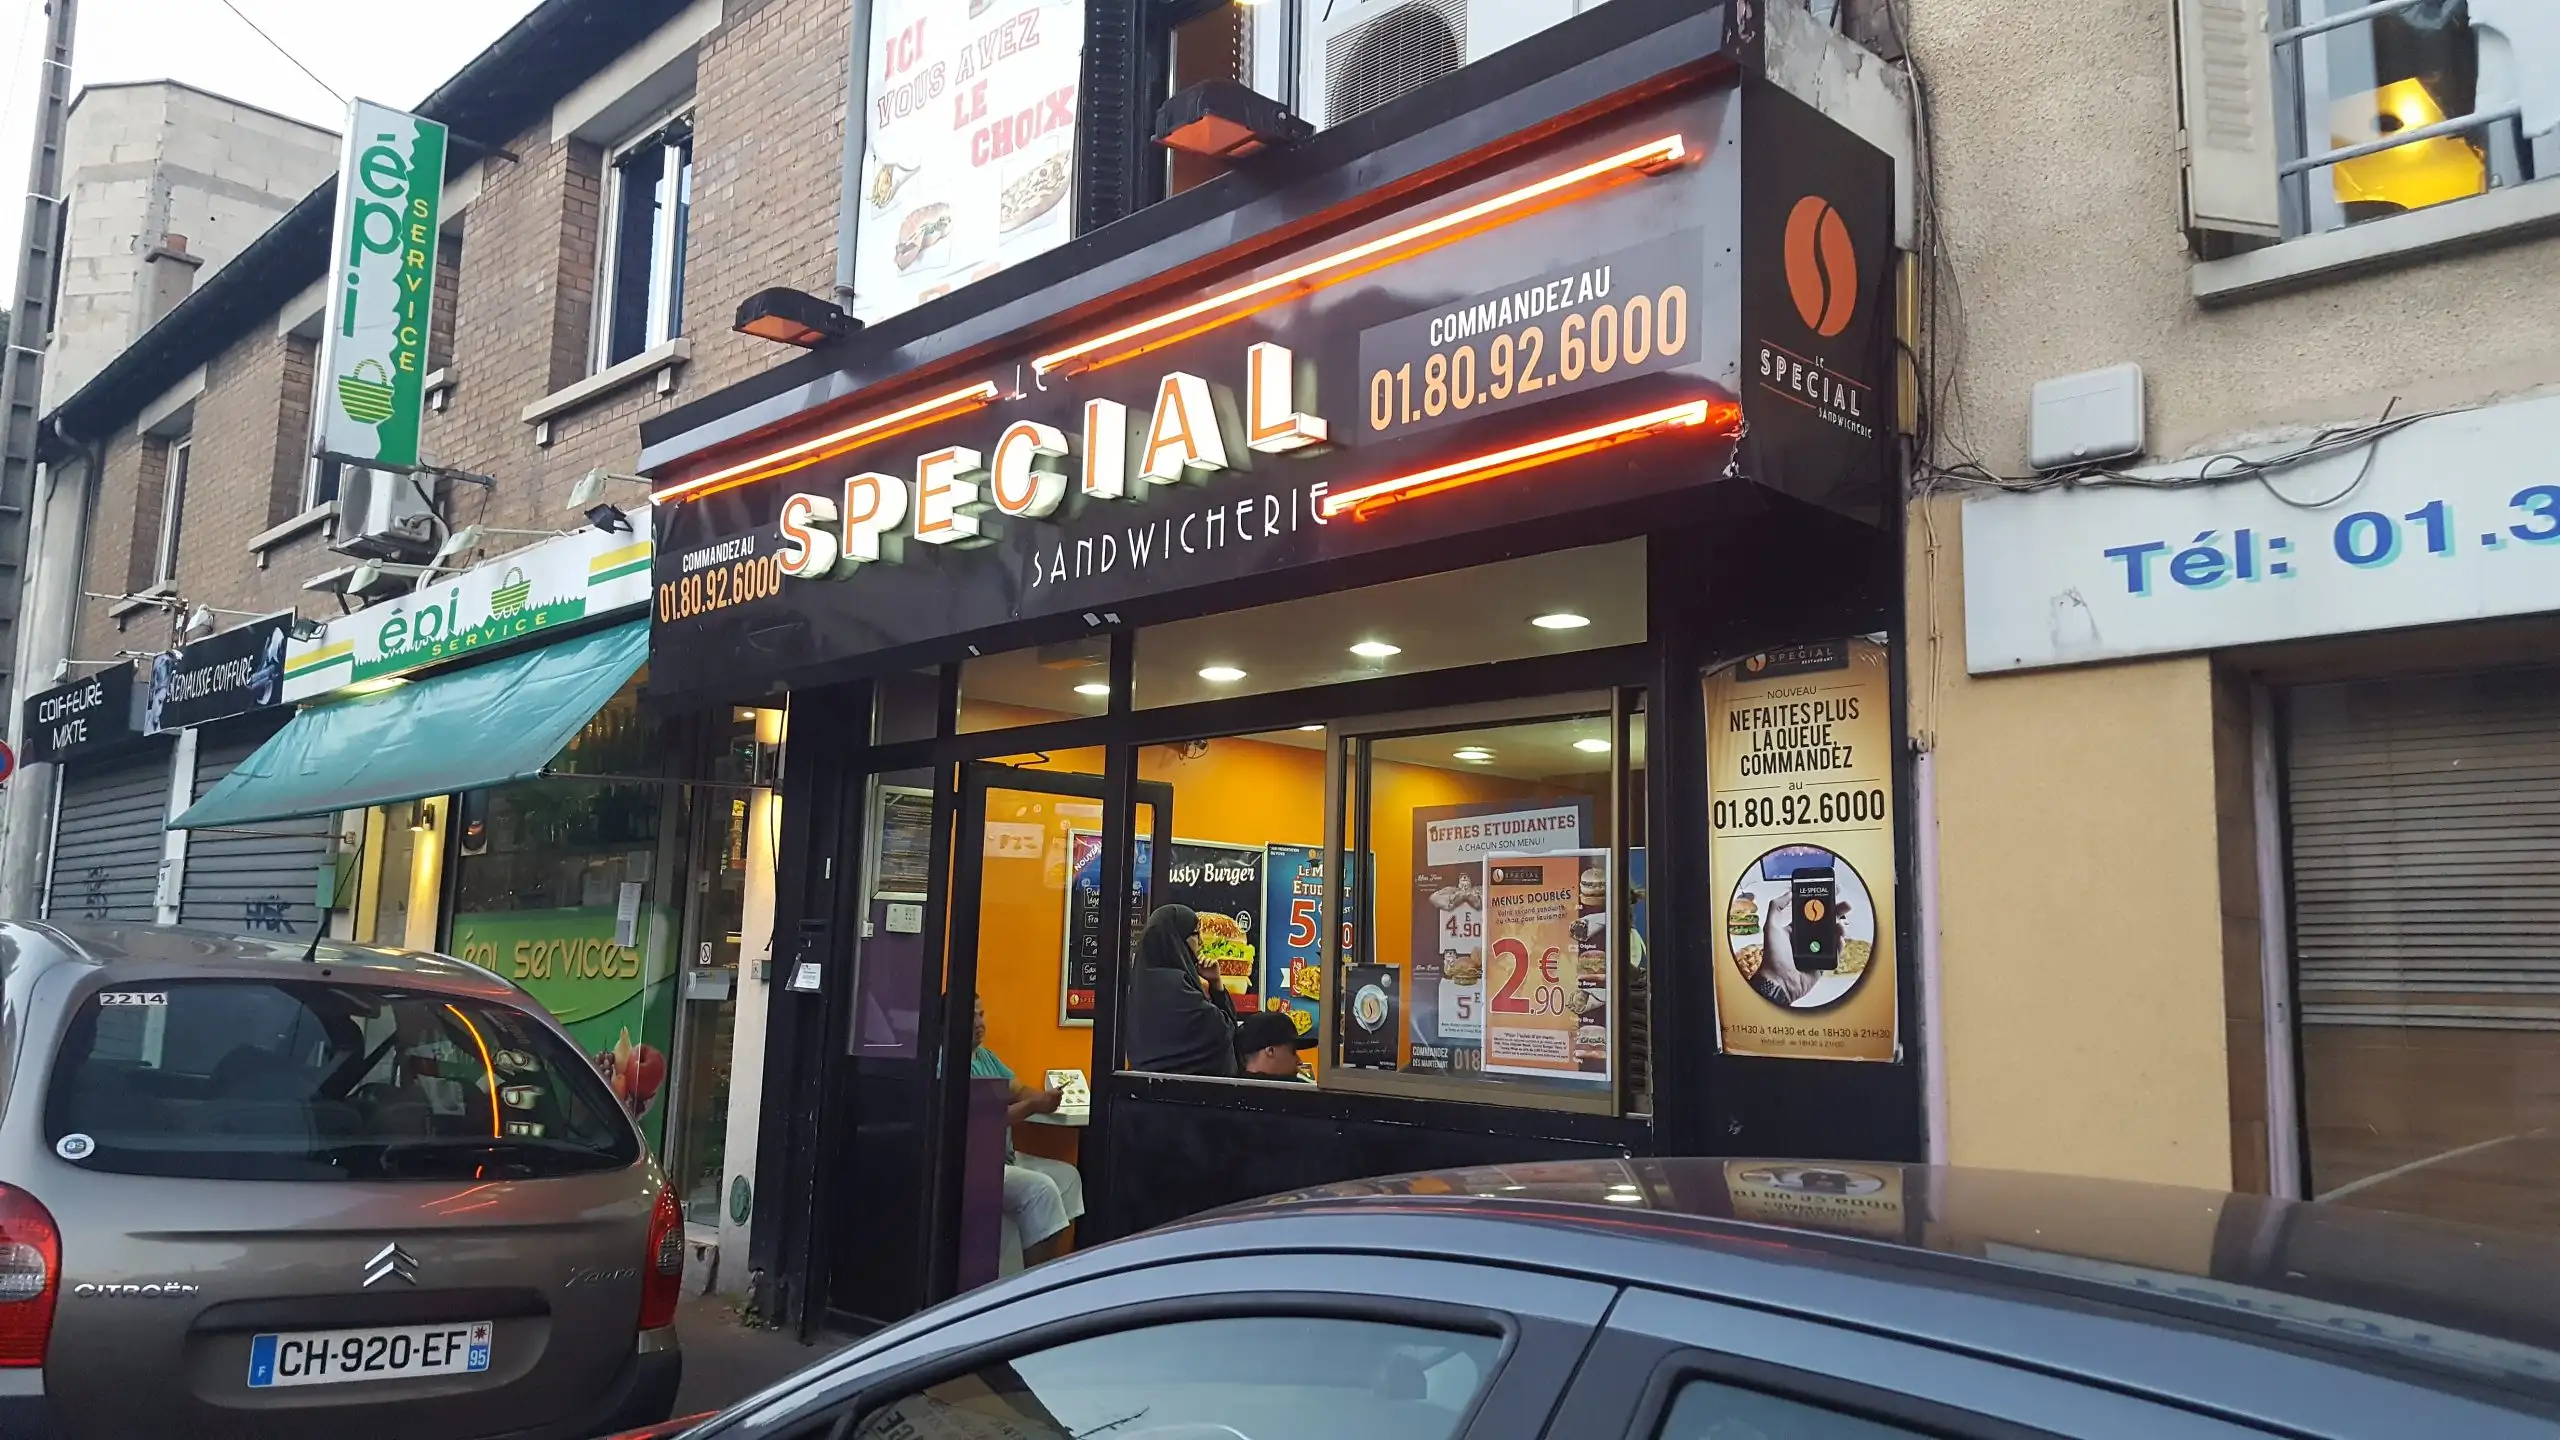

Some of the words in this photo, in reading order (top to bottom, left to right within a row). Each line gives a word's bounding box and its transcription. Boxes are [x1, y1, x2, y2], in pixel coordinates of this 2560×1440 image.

[877, 61, 946, 129] VOUS
[955, 7, 1040, 86] AVEZ
[885, 16, 927, 81] ICI
[953, 78, 988, 131] LE
[971, 84, 1075, 168] CHOIX
[398, 198, 429, 372] SERVICE
[1430, 276, 1574, 347] COMMANDEZ
[1578, 265, 1611, 304] AU
[1369, 284, 1688, 431] 01.80.92.6000
[1760, 348, 1860, 417] SPECIAL
[1819, 407, 1872, 439] SANDWICHERIE
[776, 340, 1328, 579] SPECIAL
[682, 539, 740, 573] COMMANDEZ
[741, 535, 755, 556] AU
[1031, 481, 1329, 588] SANDWICHERIE
[2104, 528, 2295, 597] Tél:
[660, 552, 780, 623] 01.80.92.6000
[378, 587, 460, 655] épi
[431, 611, 547, 656] SERVICE
[213, 655, 254, 692] COIFFURE
[1769, 648, 1834, 663] SPECIAL
[39, 682, 103, 723] COIFFEURE
[1767, 686, 1817, 699] NOUVEAU
[52, 718, 87, 750] MIXTE
[1730, 710, 1751, 732] NE
[1753, 703, 1811, 730] FAITES
[1813, 697, 1860, 723] PLUS
[1753, 729, 1773, 752] LA
[1740, 746, 1853, 777] COMMANDEZ
[1788, 781, 1803, 791] au
[1429, 825, 1480, 843] OFFRES
[1484, 814, 1576, 837] ETUDIANTES
[1713, 789, 1885, 829] 01.80.92.6000
[1458, 844, 1464, 852] A
[1465, 841, 1498, 851] CHACUN
[1499, 839, 1516, 849] SON
[1517, 838, 1541, 847] MENU
[1168, 865, 1200, 887] usty
[1204, 863, 1255, 886] Burger
[1491, 894, 1525, 907] MENUS
[101, 993, 166, 1005] 2214
[1731, 1025, 1758, 1034] 11H30
[1768, 1026, 1795, 1036] 14H30
[1808, 1028, 1820, 1037] de
[1823, 1028, 1851, 1038] 18H30
[1862, 1029, 1890, 1039] 21H30
[74, 1281, 199, 1299] CITROËN
[258, 1365, 267, 1378] F
[278, 1330, 468, 1377] CH-920-EF
[469, 1349, 488, 1367] 95
